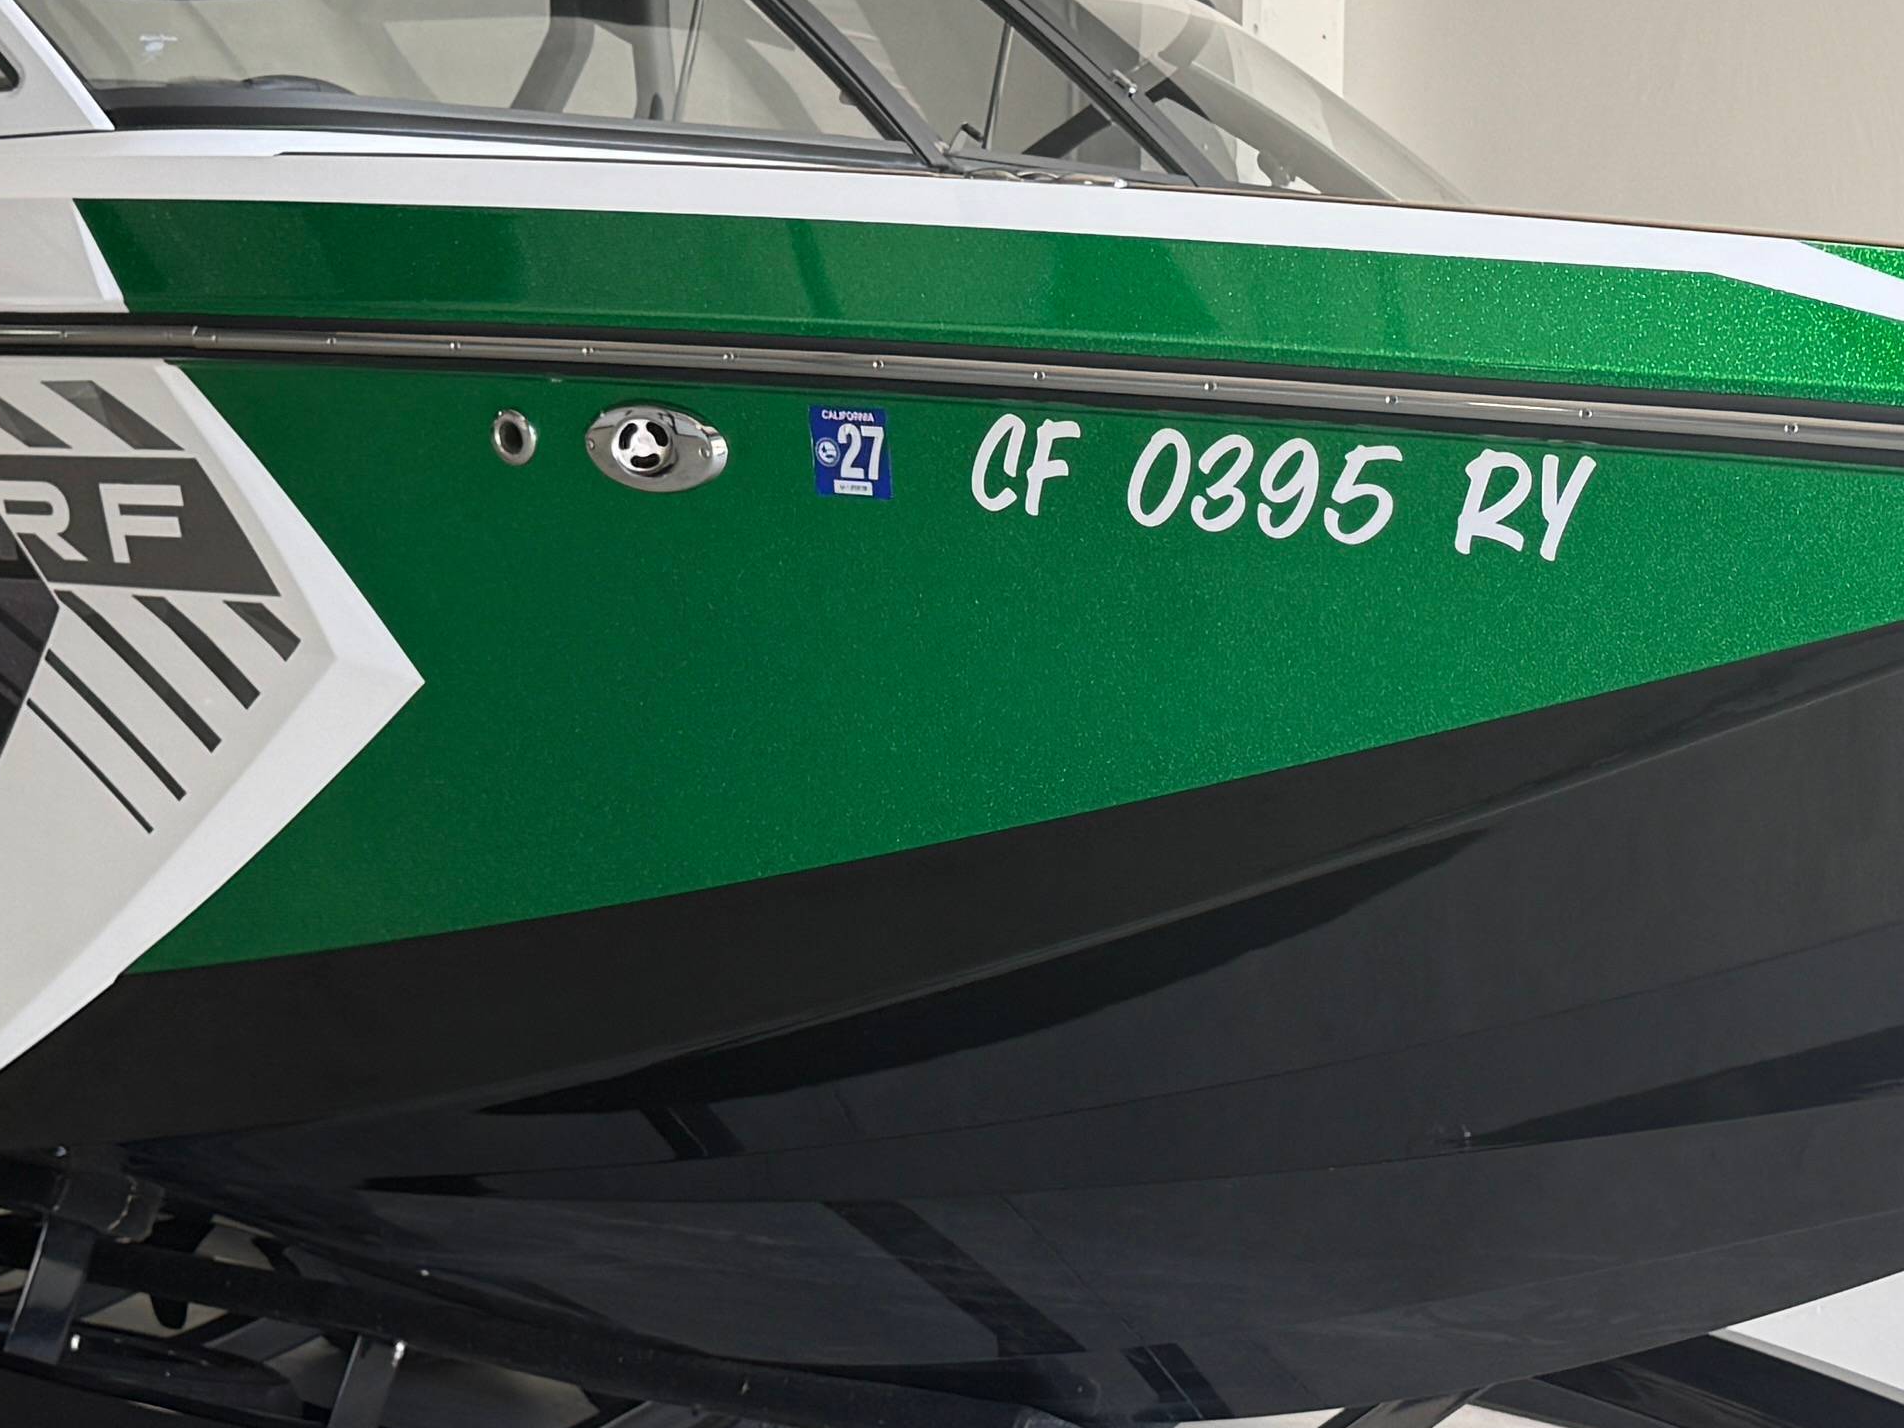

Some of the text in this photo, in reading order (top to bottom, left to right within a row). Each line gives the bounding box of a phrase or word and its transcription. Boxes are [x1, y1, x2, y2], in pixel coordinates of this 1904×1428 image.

[821, 409, 875, 423] CALIFORNIA
[837, 422, 885, 481] 27
[970, 413, 1597, 562] CF 0395 RY
